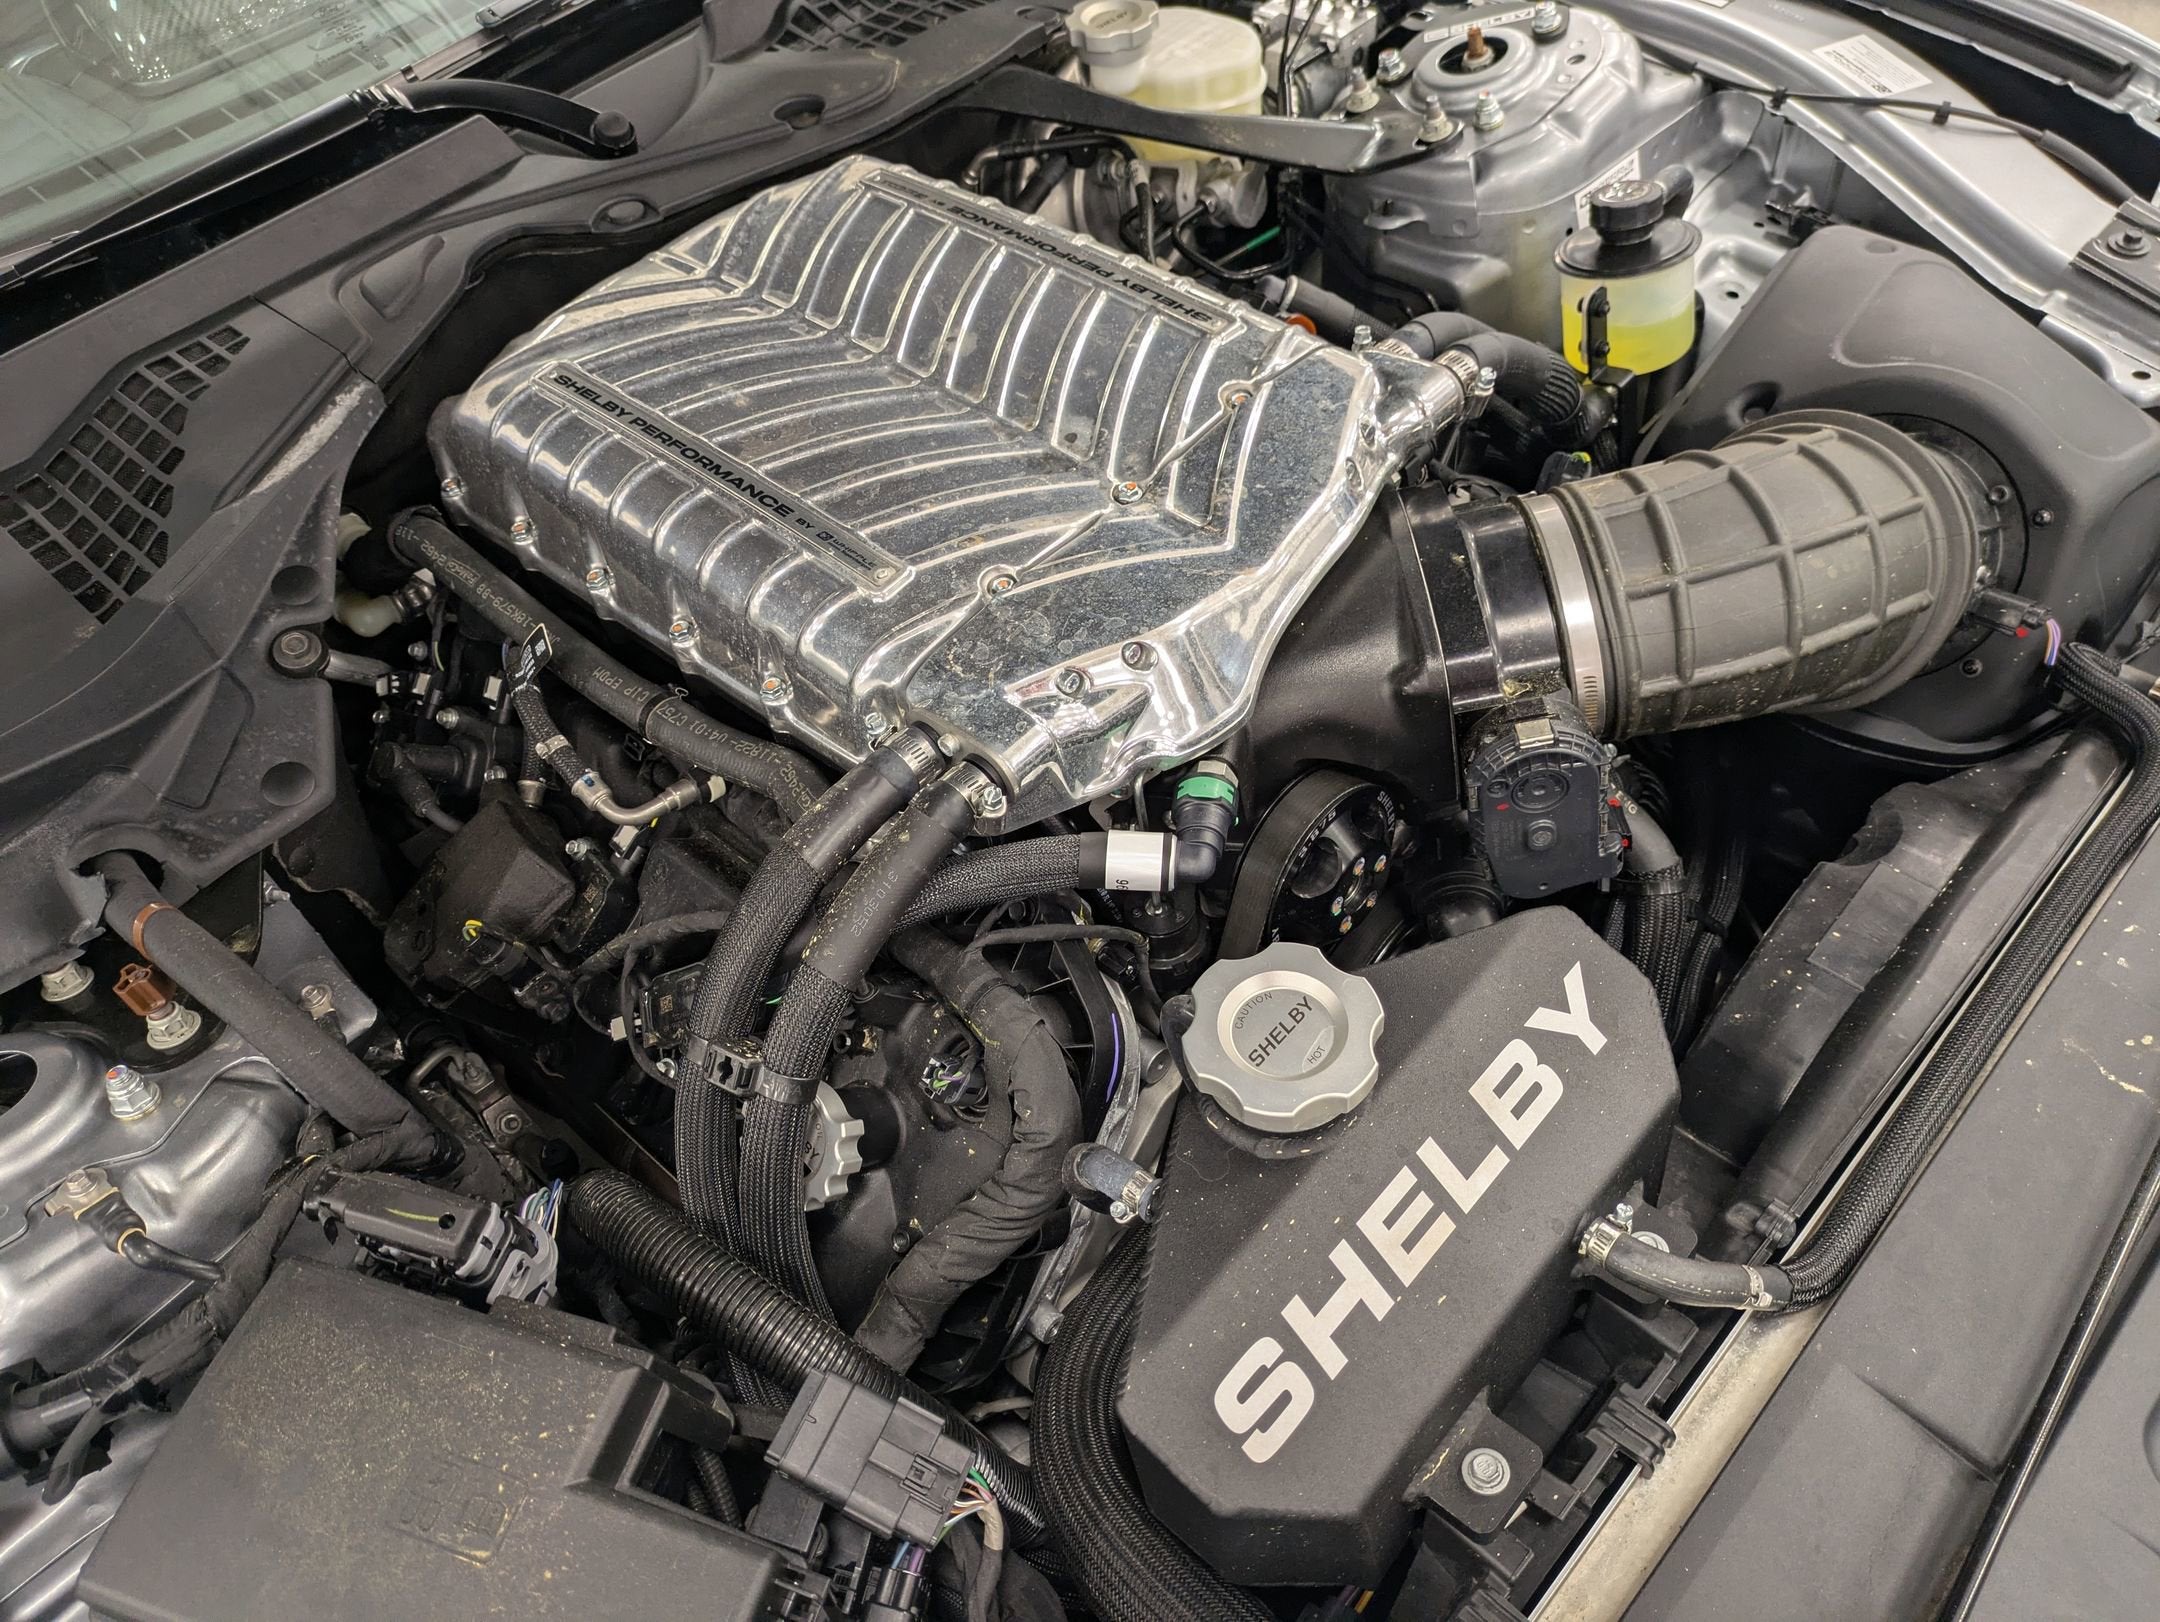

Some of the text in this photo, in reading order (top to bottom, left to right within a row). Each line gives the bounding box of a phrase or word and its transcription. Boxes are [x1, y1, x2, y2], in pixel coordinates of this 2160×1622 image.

[947, 206, 1115, 278] PERFORMANCE
[1113, 278, 1213, 323] SHELBY
[553, 374, 877, 568] SHELBY PERFORMANCE BY WHIPPLE
[591, 666, 624, 691] EPDM
[1377, 790, 1396, 832] SHELBY
[1234, 991, 1273, 1029] CAUTION
[1248, 995, 1313, 1067] SHELBY
[1306, 1045, 1326, 1064] HOT
[1214, 960, 1608, 1464] SHELBY
